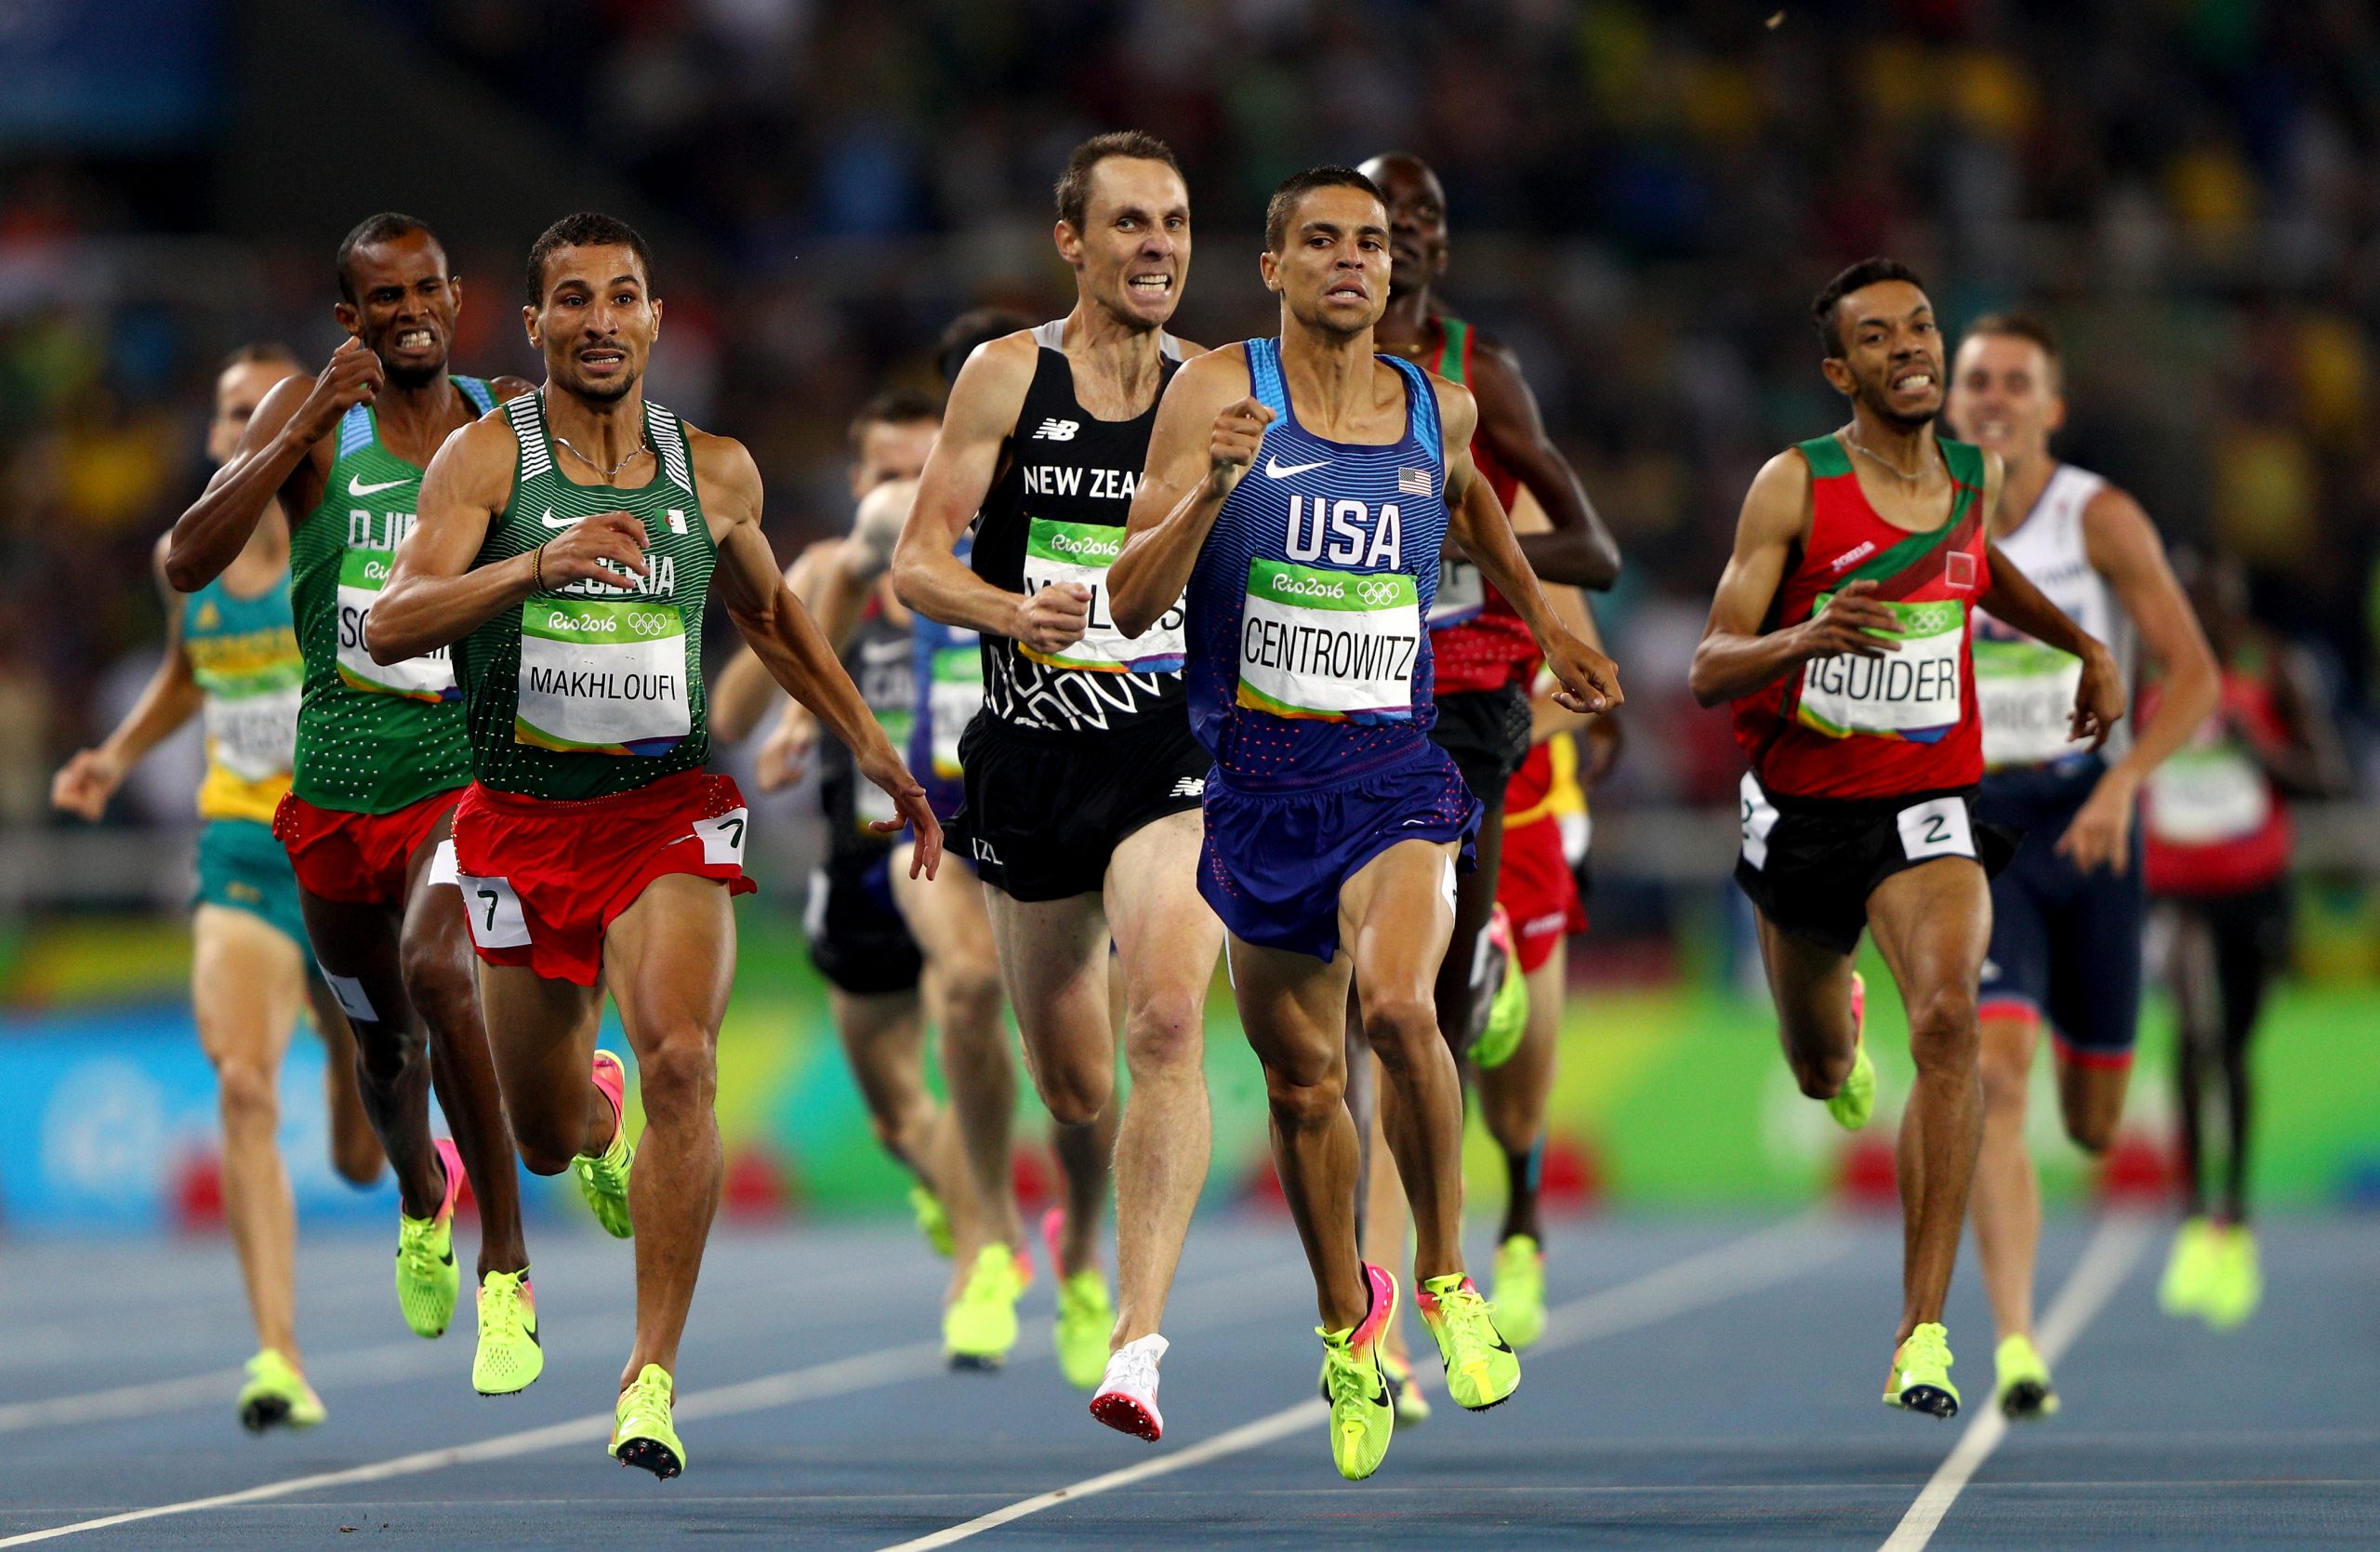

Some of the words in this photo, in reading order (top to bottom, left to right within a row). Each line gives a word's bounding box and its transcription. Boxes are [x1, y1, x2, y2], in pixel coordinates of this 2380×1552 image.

[1024, 466, 1083, 496] NEW
[1089, 469, 1144, 499] ZEA
[1286, 495, 1402, 570] USA
[1245, 617, 1416, 681] CENTROWITZ
[530, 667, 676, 700] MAKHLOUFI
[1809, 652, 1955, 702] IGUIDER
[718, 818, 744, 848] 7
[1923, 815, 1951, 843] 2
[477, 889, 498, 931] 7
